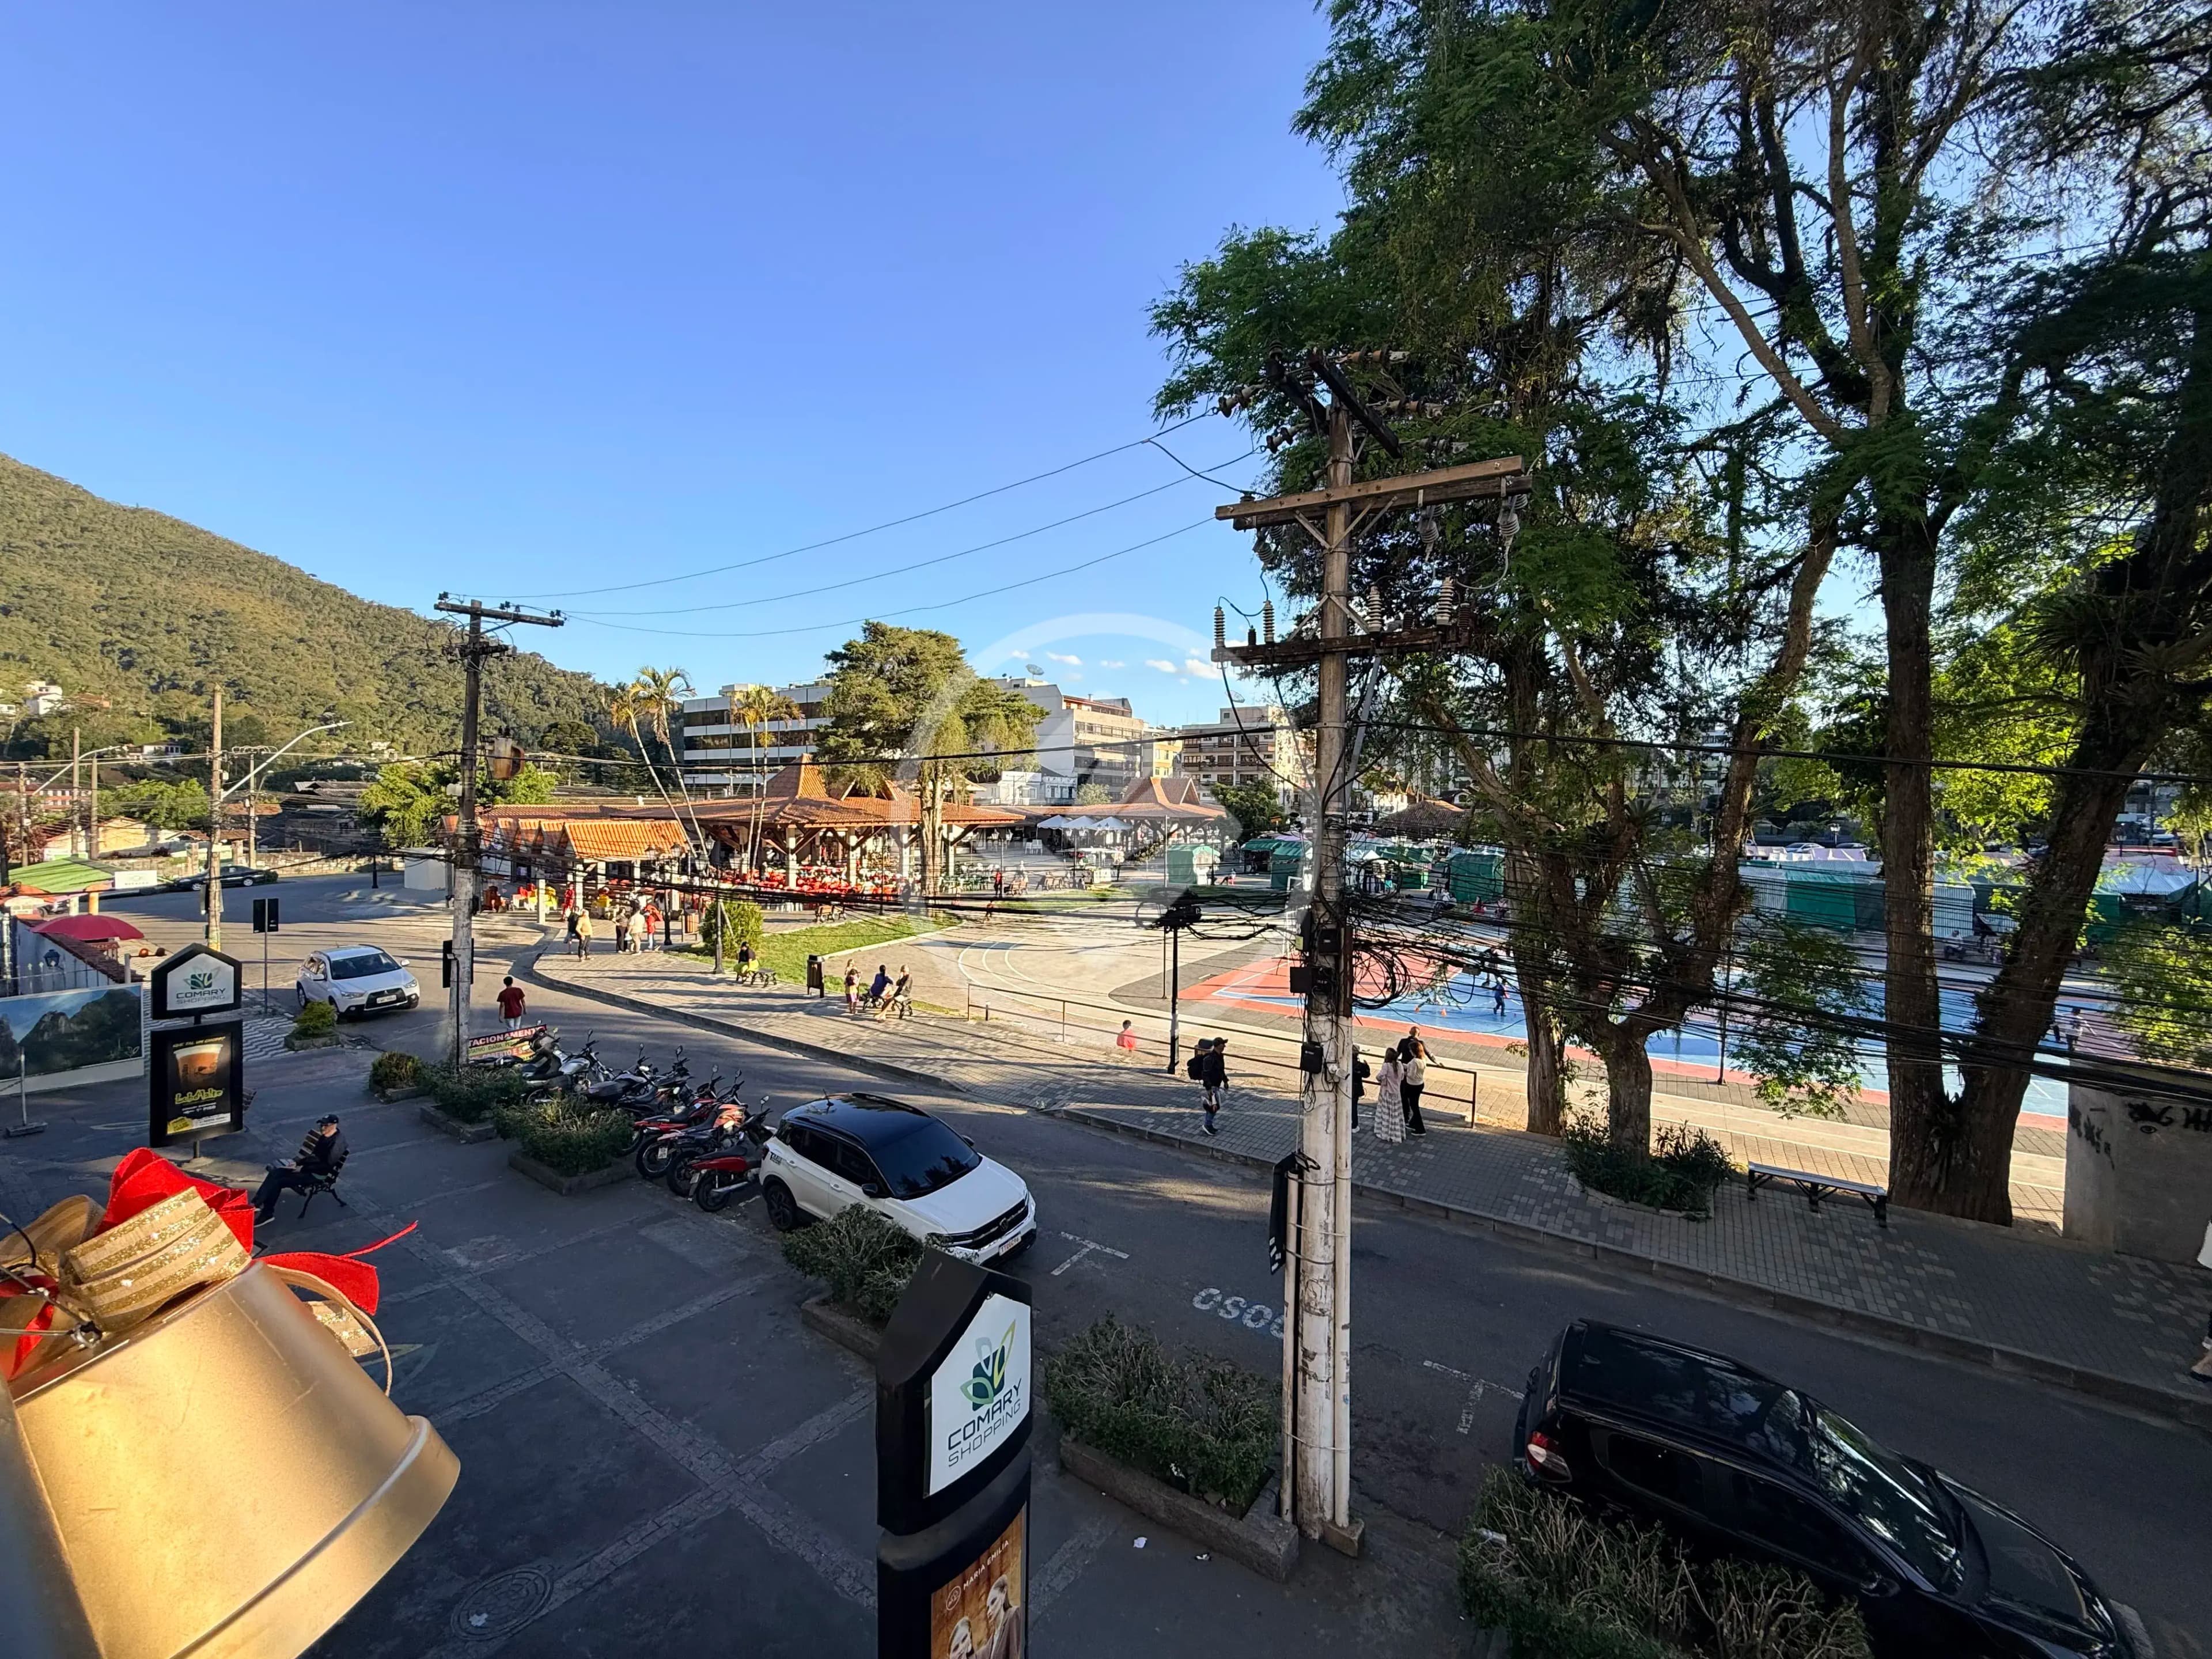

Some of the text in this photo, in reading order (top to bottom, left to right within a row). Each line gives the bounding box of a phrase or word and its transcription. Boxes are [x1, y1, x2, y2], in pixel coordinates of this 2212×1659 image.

[176, 988, 226, 999] COMARY
[176, 995, 225, 1004] SHOPPING
[948, 1378, 1021, 1450] COMARY
[949, 1398, 1021, 1467] SHOPPING
[963, 1564, 986, 1590] MARIA
